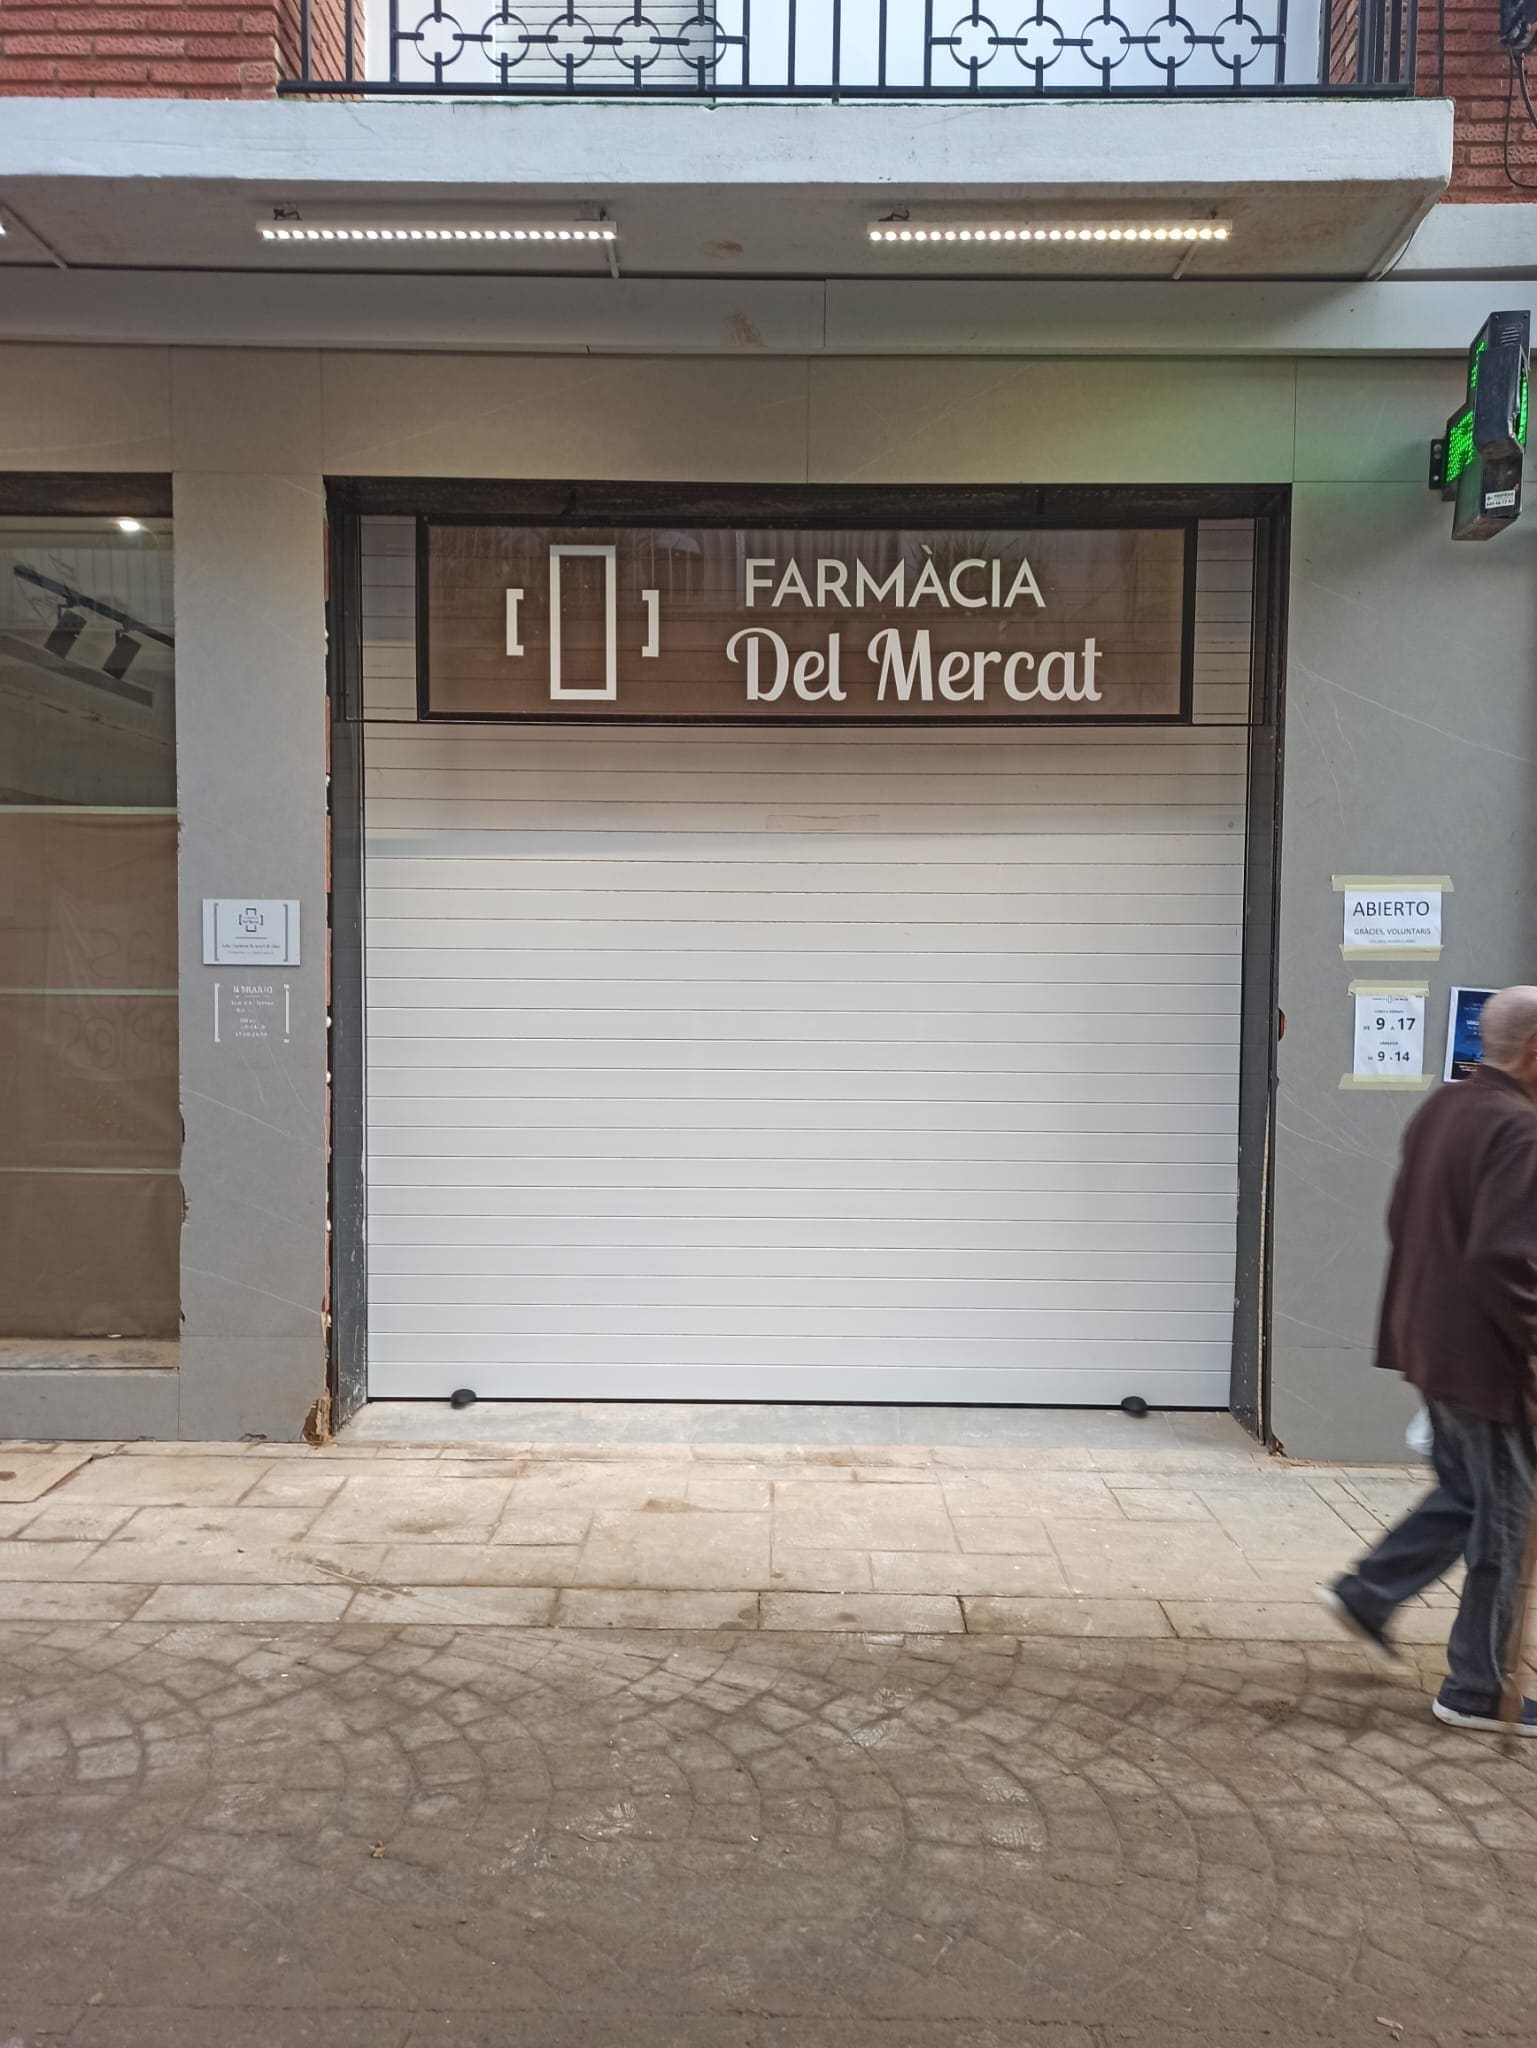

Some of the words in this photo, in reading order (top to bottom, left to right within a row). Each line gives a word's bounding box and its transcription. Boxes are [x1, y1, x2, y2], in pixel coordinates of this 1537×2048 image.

[744, 544, 1047, 608] FARMÀCIA
[727, 628, 847, 702] Del
[868, 628, 1103, 702] Mercat
[1353, 901, 1430, 917] ABIERTO
[1387, 927, 1432, 935] VOLUNTARIS
[1376, 1017, 1385, 1030] 9
[1398, 1017, 1416, 1031] 17
[1377, 1051, 1385, 1062] 9
[1395, 1051, 1410, 1062] 14
